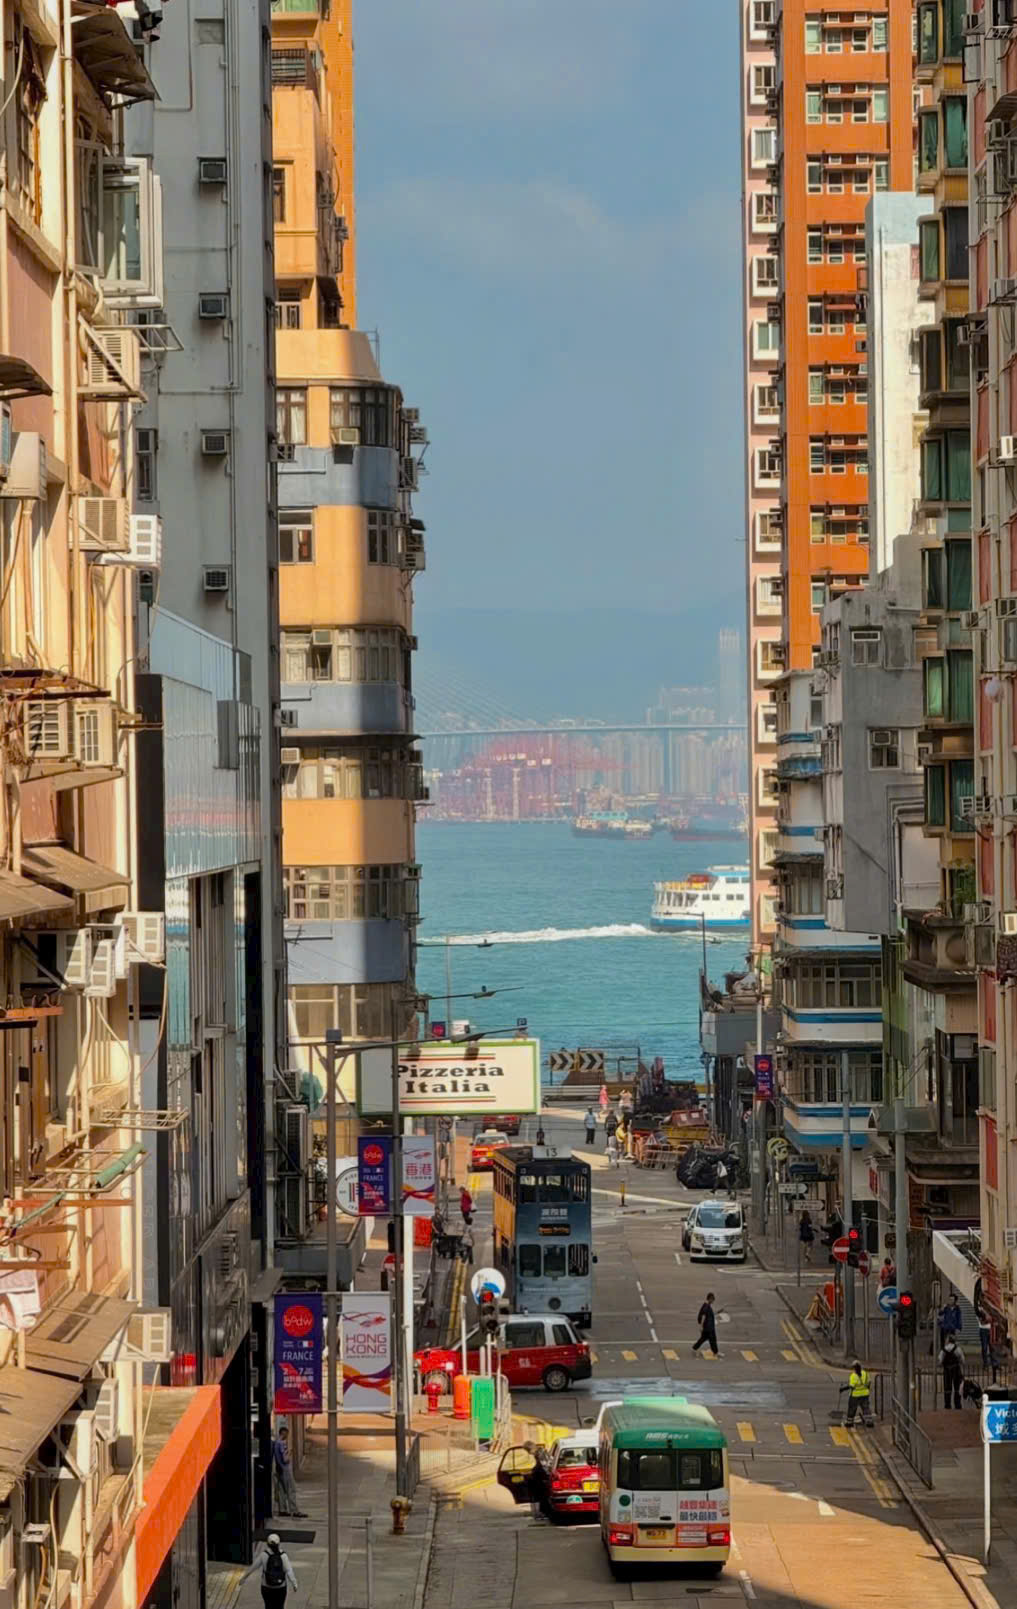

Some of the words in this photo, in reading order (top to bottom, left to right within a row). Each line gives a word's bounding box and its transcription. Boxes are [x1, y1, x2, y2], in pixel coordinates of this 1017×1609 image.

[391, 1064, 504, 1078] Pizzeria
[405, 1080, 490, 1093] Italia
[545, 1147, 558, 1157] 13
[345, 1333, 387, 1344] HONG
[345, 1344, 387, 1354] KONG
[282, 1351, 314, 1361] FRANCE
[993, 1408, 1017, 1418] Vict
